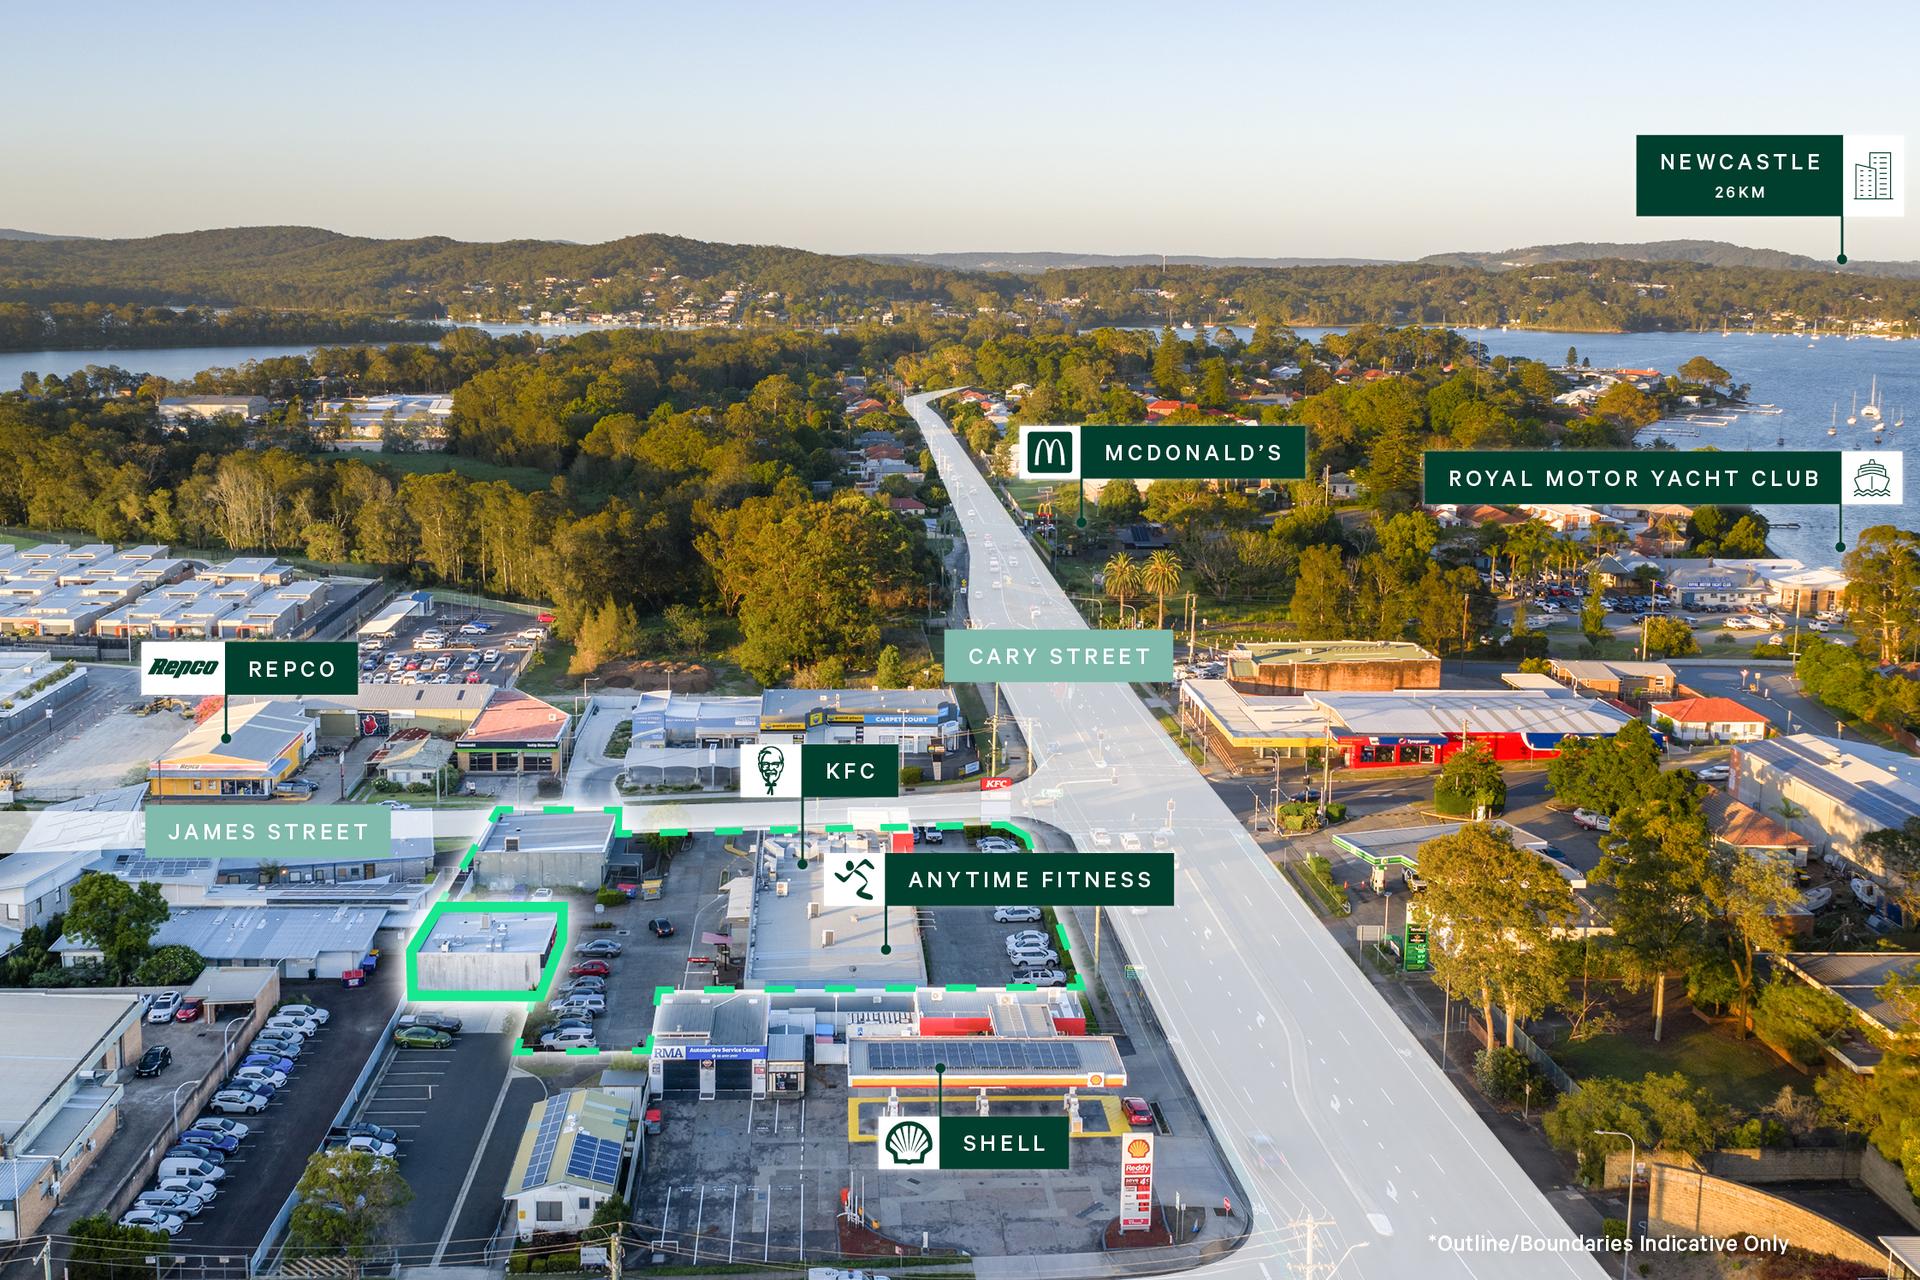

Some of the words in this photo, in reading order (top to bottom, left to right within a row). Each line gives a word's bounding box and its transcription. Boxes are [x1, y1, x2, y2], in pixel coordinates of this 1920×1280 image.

[985, 780, 1008, 788] KFC
[654, 1047, 684, 1059] RMA
[1126, 1165, 1150, 1173] Reddy
